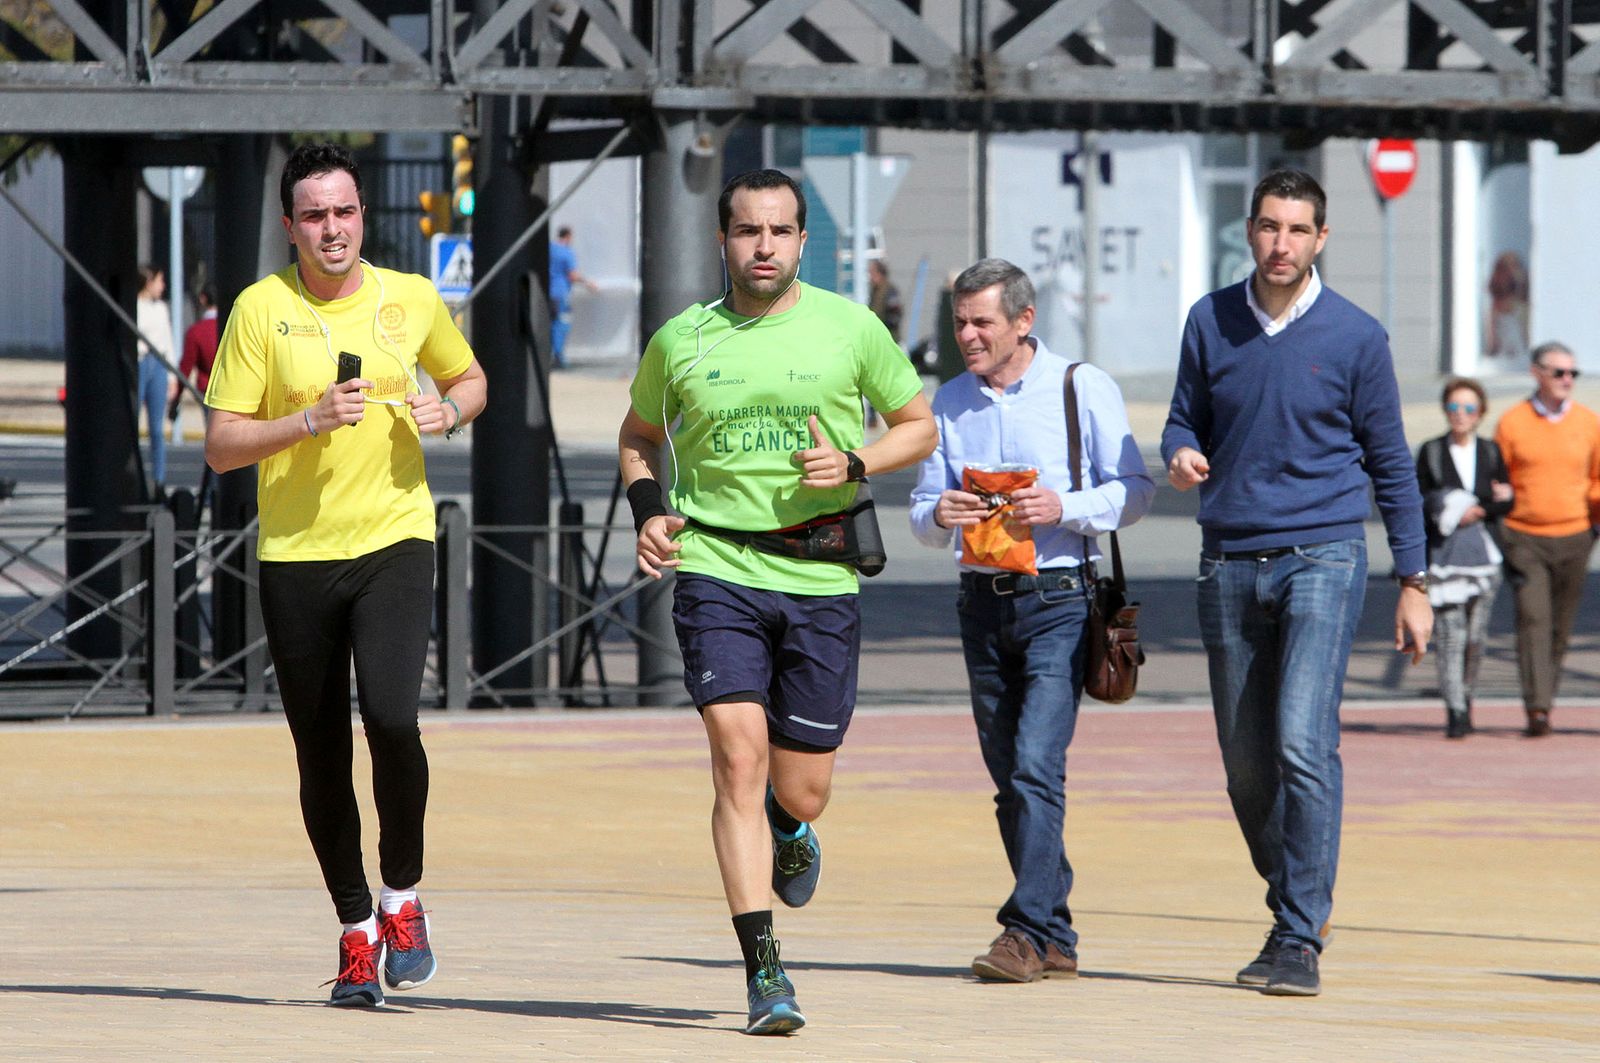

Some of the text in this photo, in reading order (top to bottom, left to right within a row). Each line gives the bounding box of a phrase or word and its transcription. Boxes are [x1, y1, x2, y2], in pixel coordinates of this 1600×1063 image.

[282, 384, 307, 407] Liga
[376, 374, 408, 396] Rábid
[707, 405, 820, 421] V CARRERA MADRID
[728, 417, 773, 431] marcha
[779, 417, 807, 429] contr
[712, 432, 733, 453] EL
